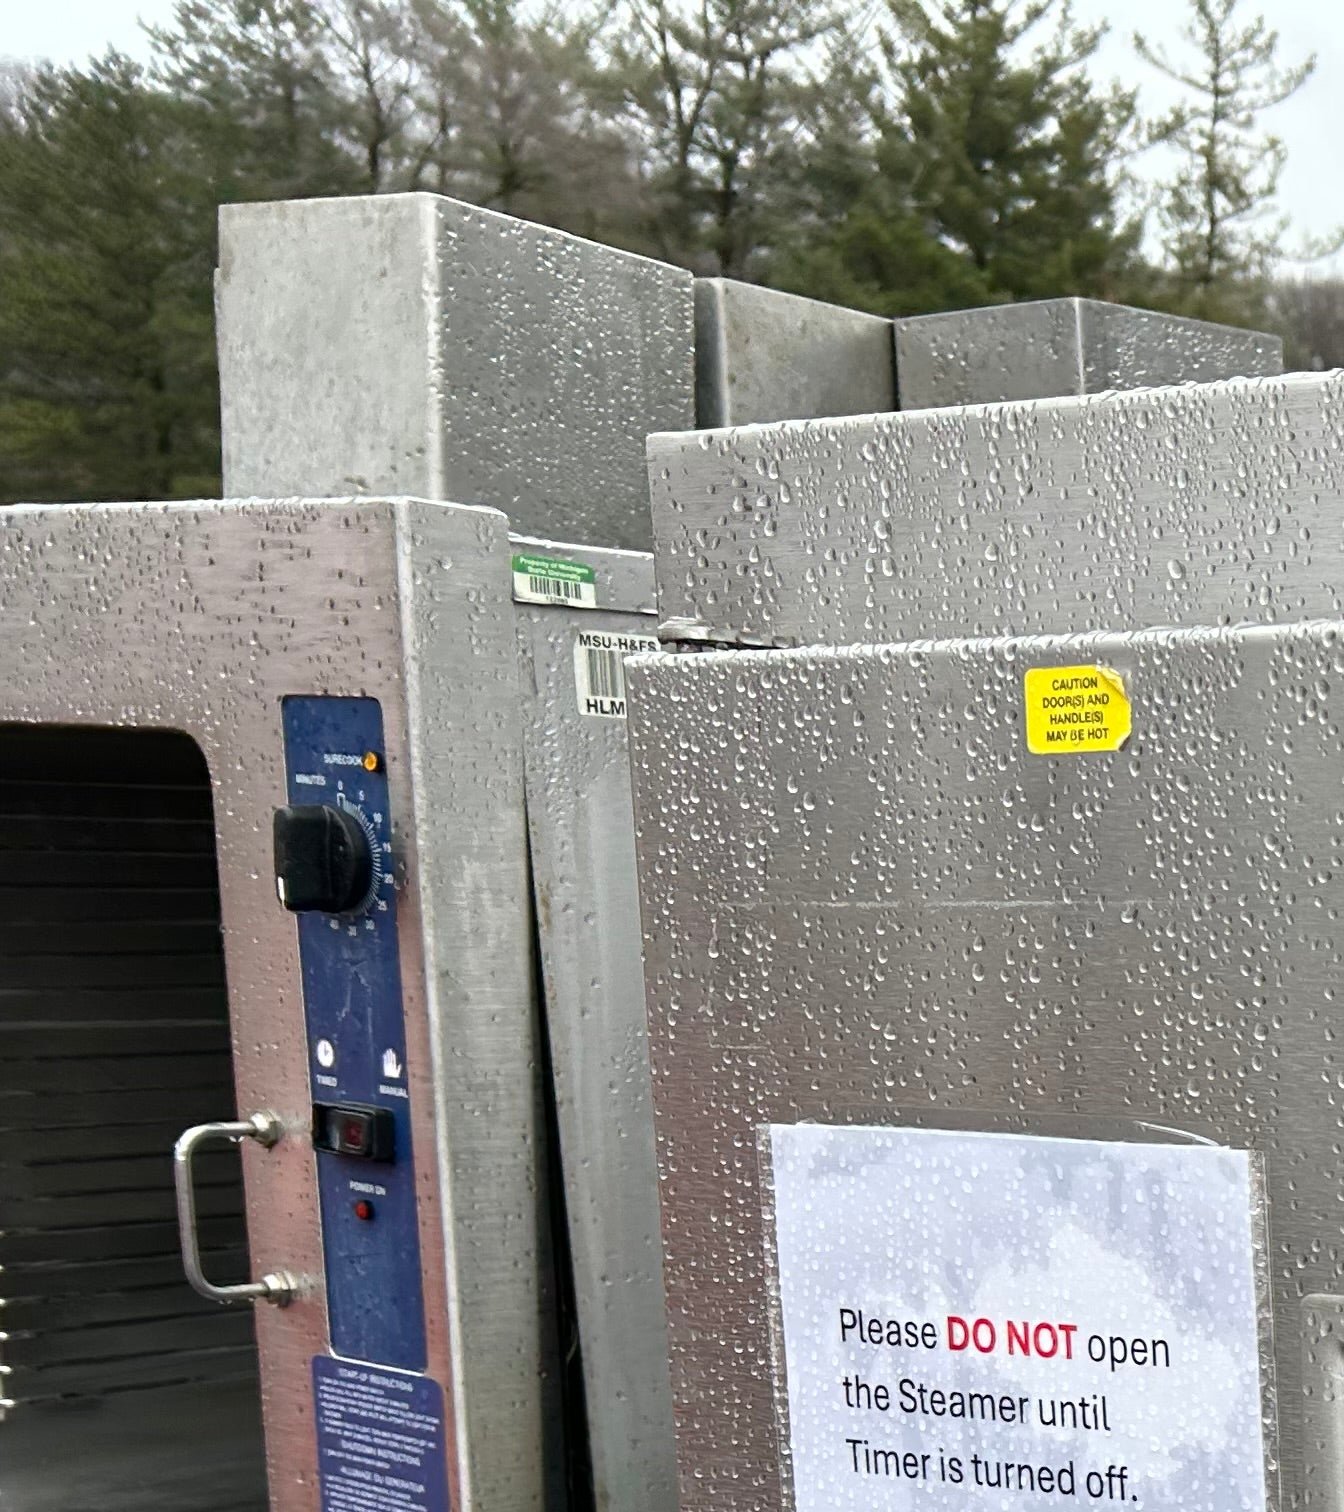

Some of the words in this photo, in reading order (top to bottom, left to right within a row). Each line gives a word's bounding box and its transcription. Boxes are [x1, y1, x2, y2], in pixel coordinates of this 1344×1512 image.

[579, 634, 657, 652] MSU-H&FS
[1052, 677, 1098, 691] CAUTION
[586, 698, 625, 715] HLM
[1042, 695, 1085, 709] DOOR(S)
[1087, 693, 1110, 706] AND
[1049, 711, 1104, 725] HANDLE(S)
[1046, 729, 1068, 742] MAY
[1070, 728, 1085, 742] BE
[1087, 727, 1110, 740] HOT
[839, 1308, 938, 1350] Please
[946, 1315, 996, 1354] DO
[1007, 1320, 1077, 1360] NOT
[1088, 1333, 1170, 1372] open
[843, 1375, 890, 1411] the
[899, 1379, 1029, 1425] Steamer
[1038, 1393, 1111, 1432] until
[845, 1438, 930, 1482] Timer
[939, 1448, 963, 1484] is
[971, 1455, 1075, 1497] turned
[1087, 1465, 1139, 1502] off.
